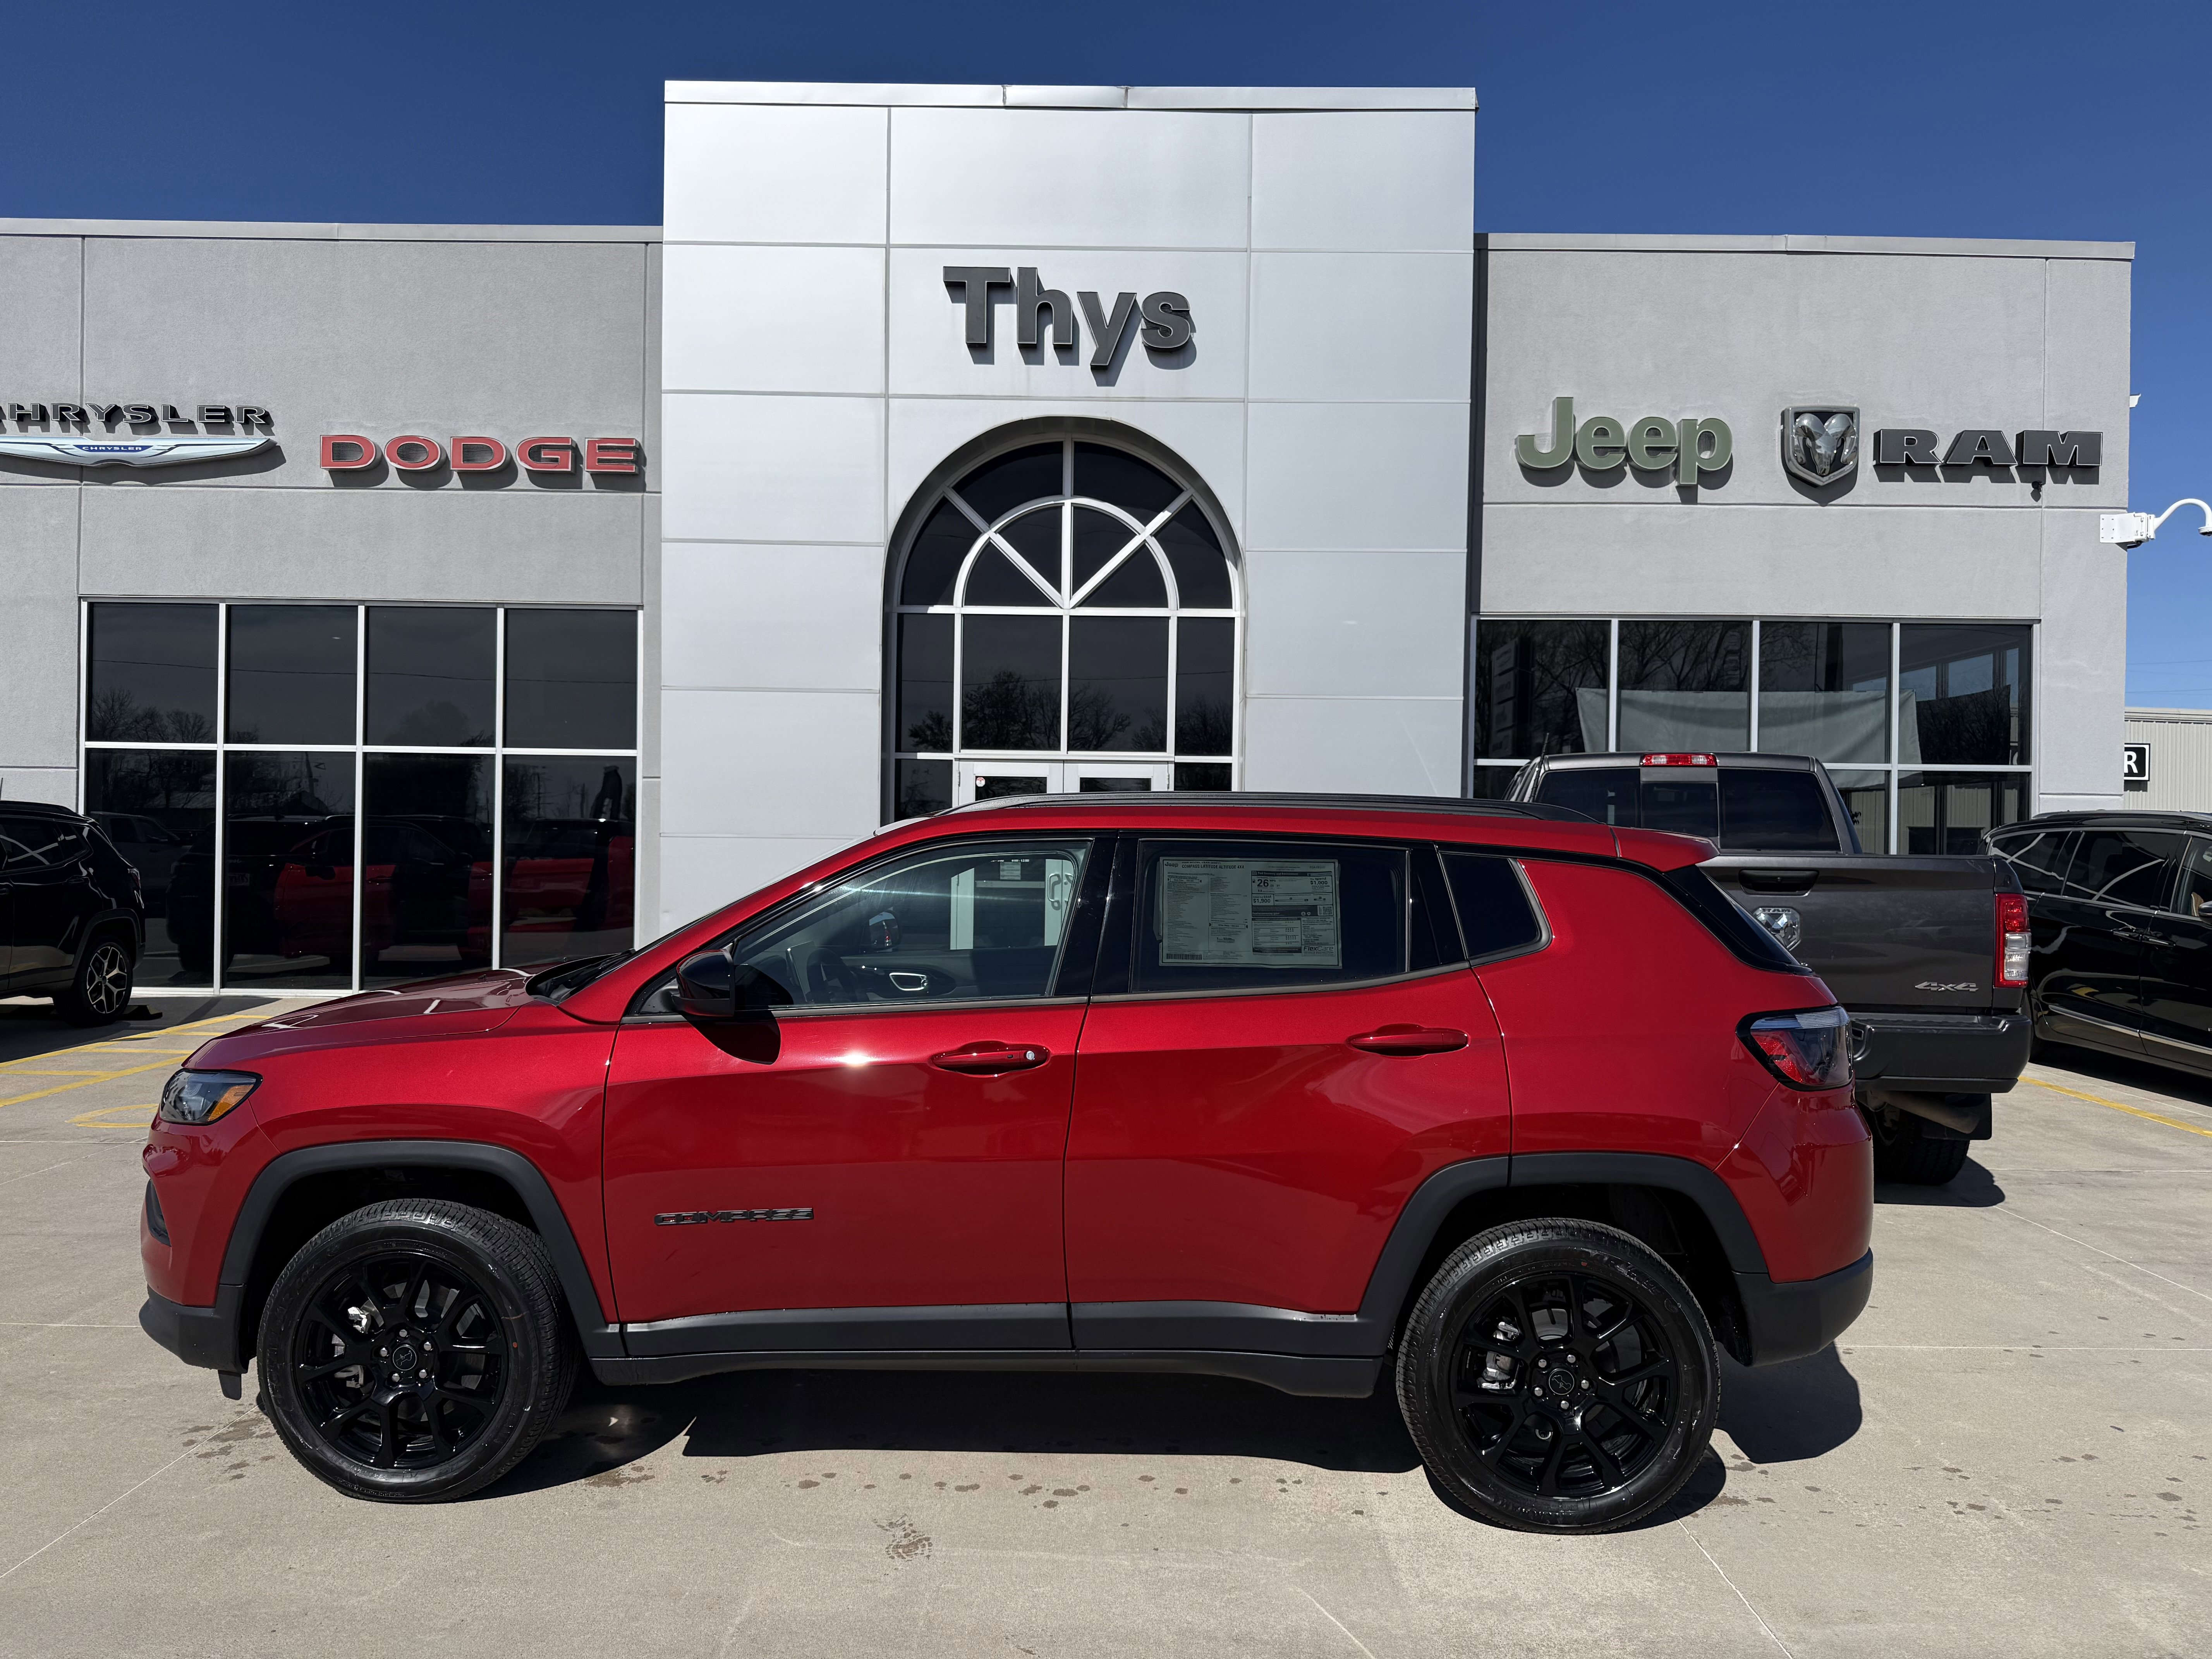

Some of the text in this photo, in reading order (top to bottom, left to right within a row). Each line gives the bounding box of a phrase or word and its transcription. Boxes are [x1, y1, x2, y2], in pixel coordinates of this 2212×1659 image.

[943, 266, 1191, 368] Thys
[0, 403, 266, 424] HRYSLER
[320, 434, 637, 473] DODGE
[1515, 397, 1733, 485] Jeep
[1874, 429, 2103, 466] RAM
[1257, 879, 1269, 887] 26
[654, 1207, 814, 1226] COMPASS
